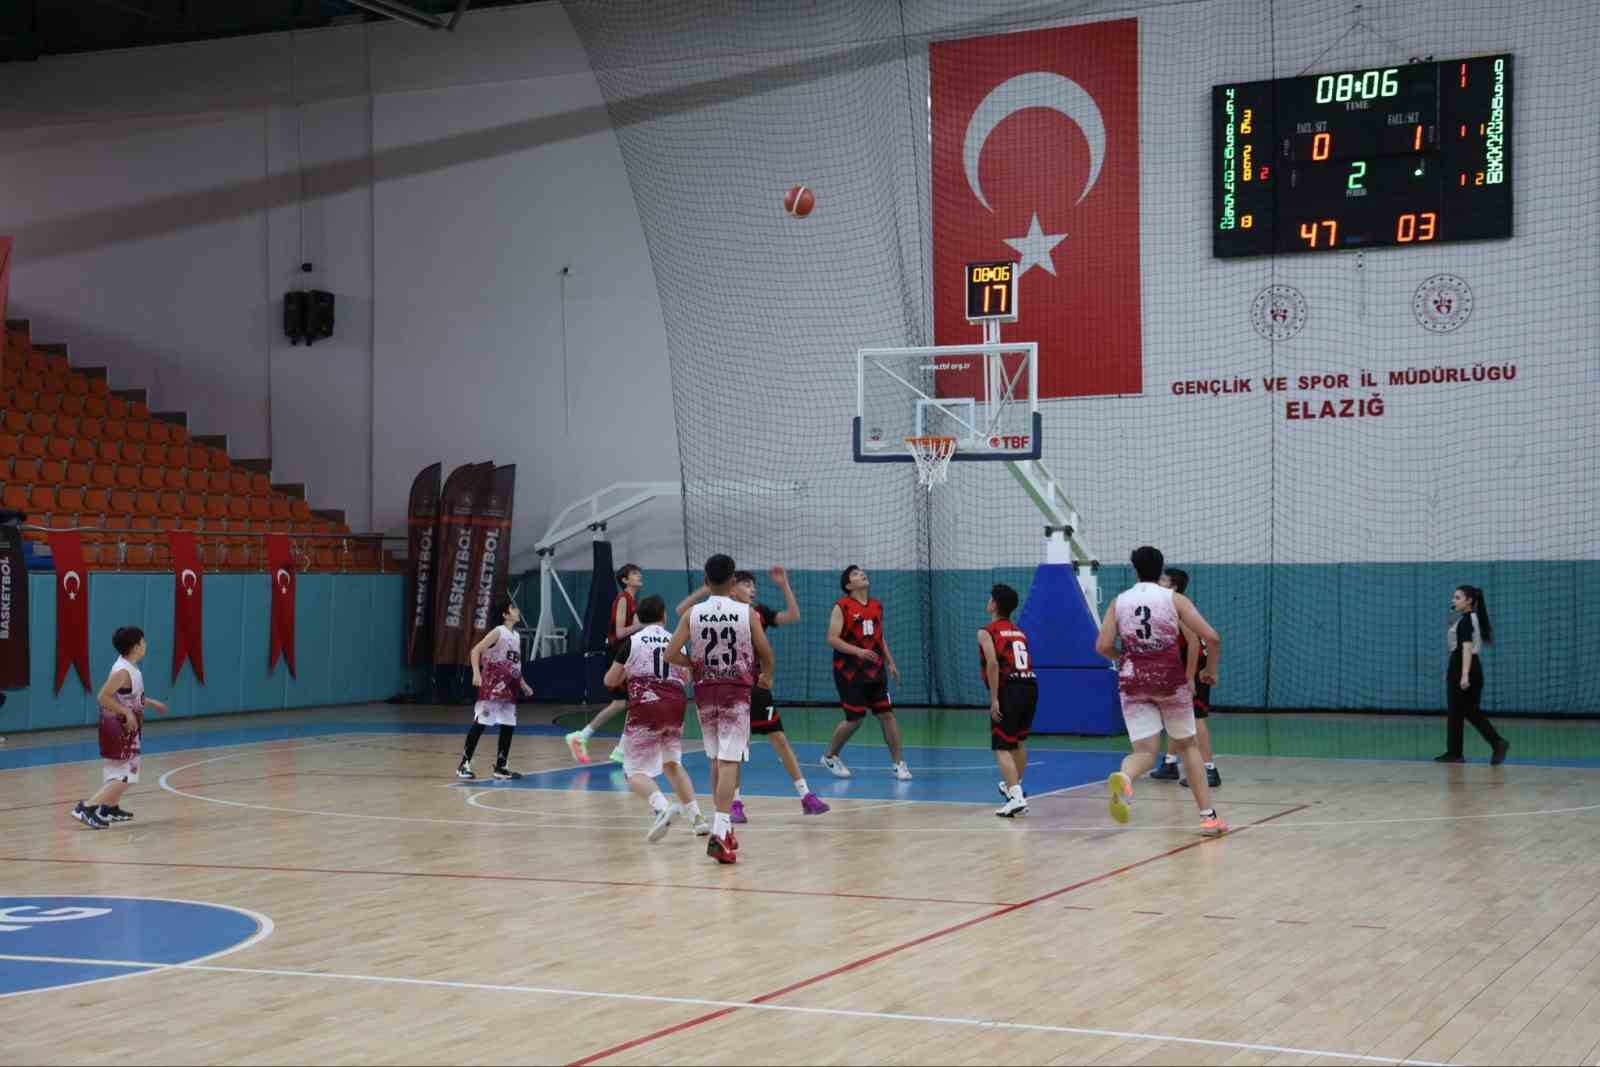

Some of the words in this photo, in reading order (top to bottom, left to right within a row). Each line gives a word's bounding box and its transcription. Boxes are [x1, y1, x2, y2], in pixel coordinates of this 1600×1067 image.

[1316, 69, 1399, 103] 08:06
[1312, 133, 1330, 161] 0
[1414, 125, 1423, 150] 1
[1260, 167, 1270, 180] 2
[1348, 161, 1367, 189] 2
[1475, 173, 1485, 185] 2
[1300, 220, 1337, 248] 47
[1397, 213, 1437, 242] 03
[983, 284, 1007, 313] 17
[1171, 378, 1252, 397] GENÇLİK
[1263, 377, 1287, 393] VE
[1298, 374, 1349, 390] SPOR
[1361, 369, 1377, 388] İL
[1286, 393, 1385, 420] ELAZIĞ
[1002, 435, 1030, 449] TBF
[0, 556, 11, 640] BASKETBOL
[699, 613, 739, 623] KAAN
[1135, 605, 1152, 640] 3
[641, 635, 670, 646] ÇINA
[701, 627, 738, 666] 23
[1012, 641, 1028, 670] 6
